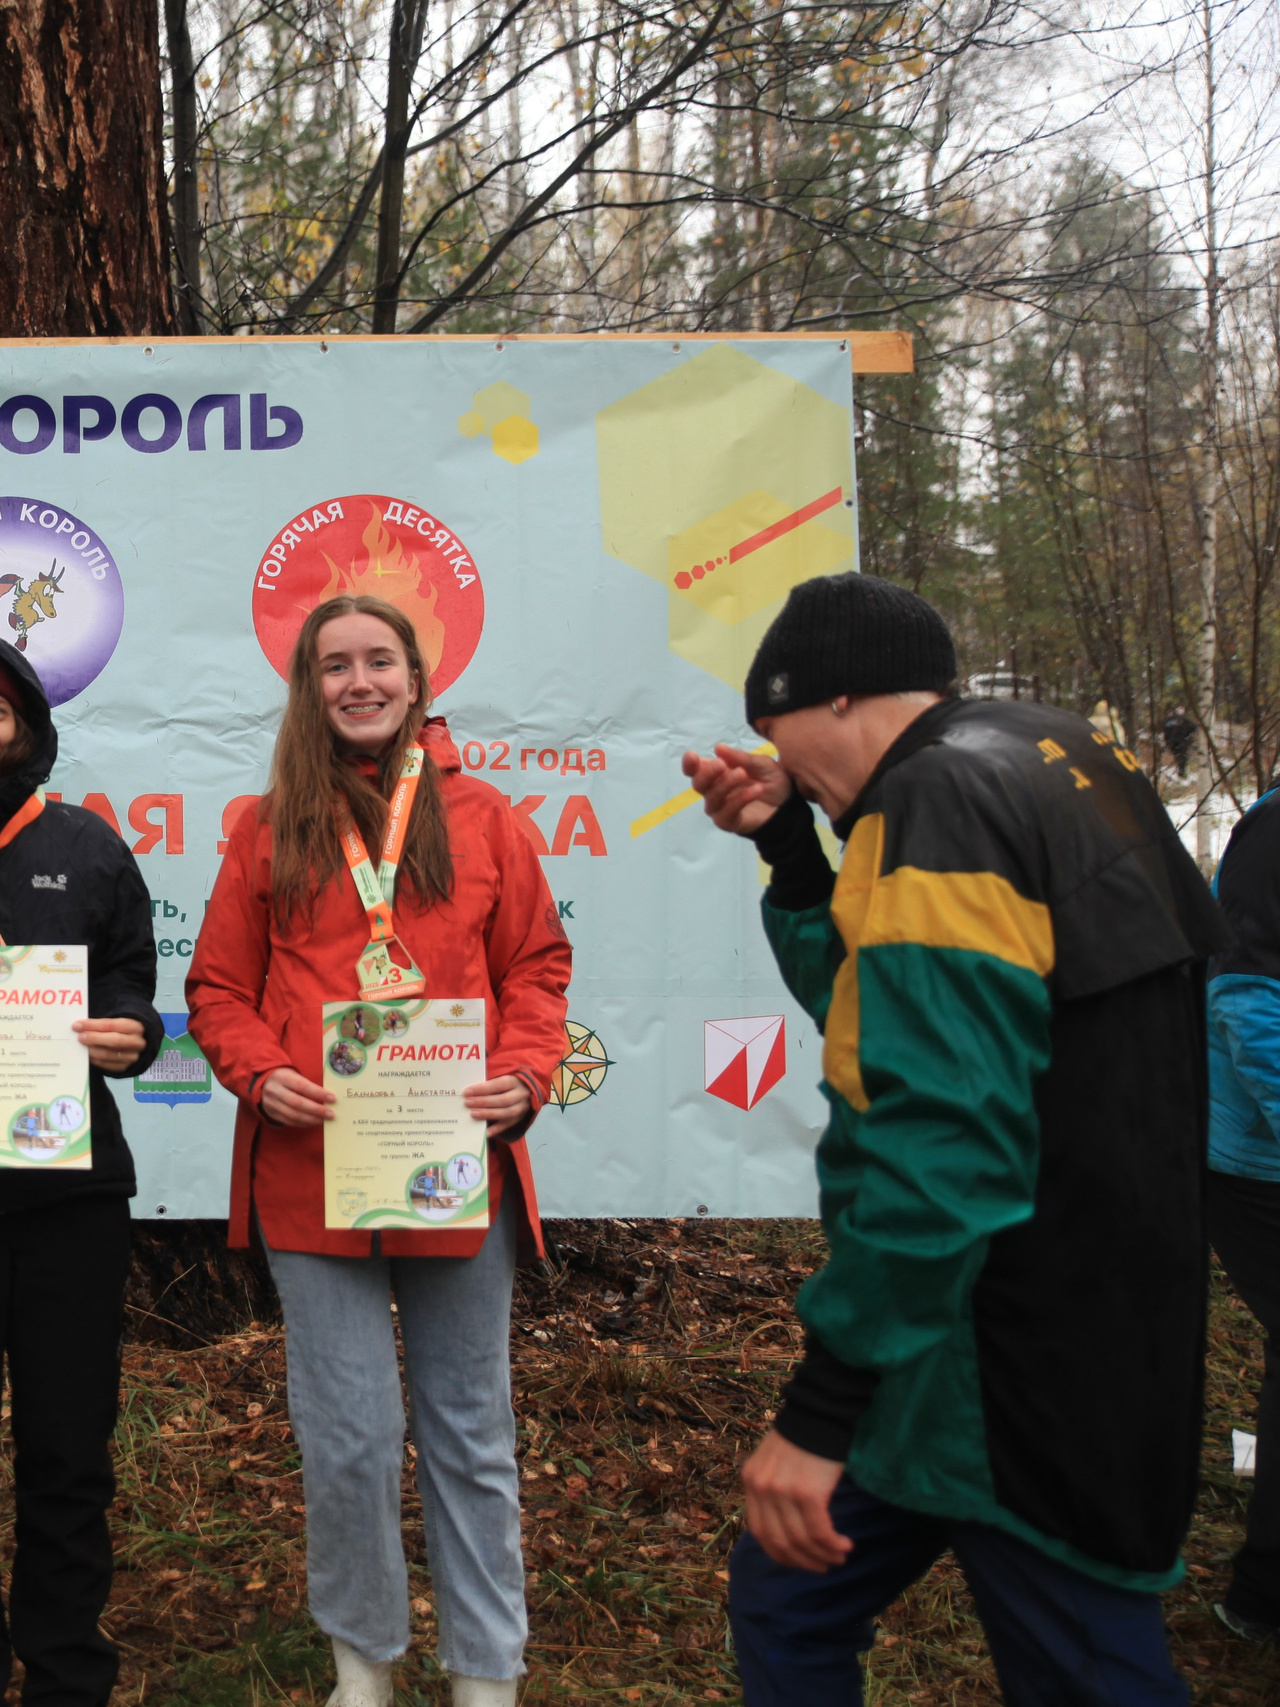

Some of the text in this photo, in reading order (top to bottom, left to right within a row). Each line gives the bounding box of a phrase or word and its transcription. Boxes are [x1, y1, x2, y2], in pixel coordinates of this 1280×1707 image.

[19, 503, 111, 581] КОРОЛЬ
[257, 501, 477, 591] ГОРЯЧАЯ ДЕСЯТКА
[520, 747, 607, 776] года
[388, 967, 403, 983] 3
[376, 1043, 481, 1062] ГРАМОТА
[378, 1070, 431, 1079] НАГРАЖДАЕТСЯ
[397, 1105, 403, 1113] 3
